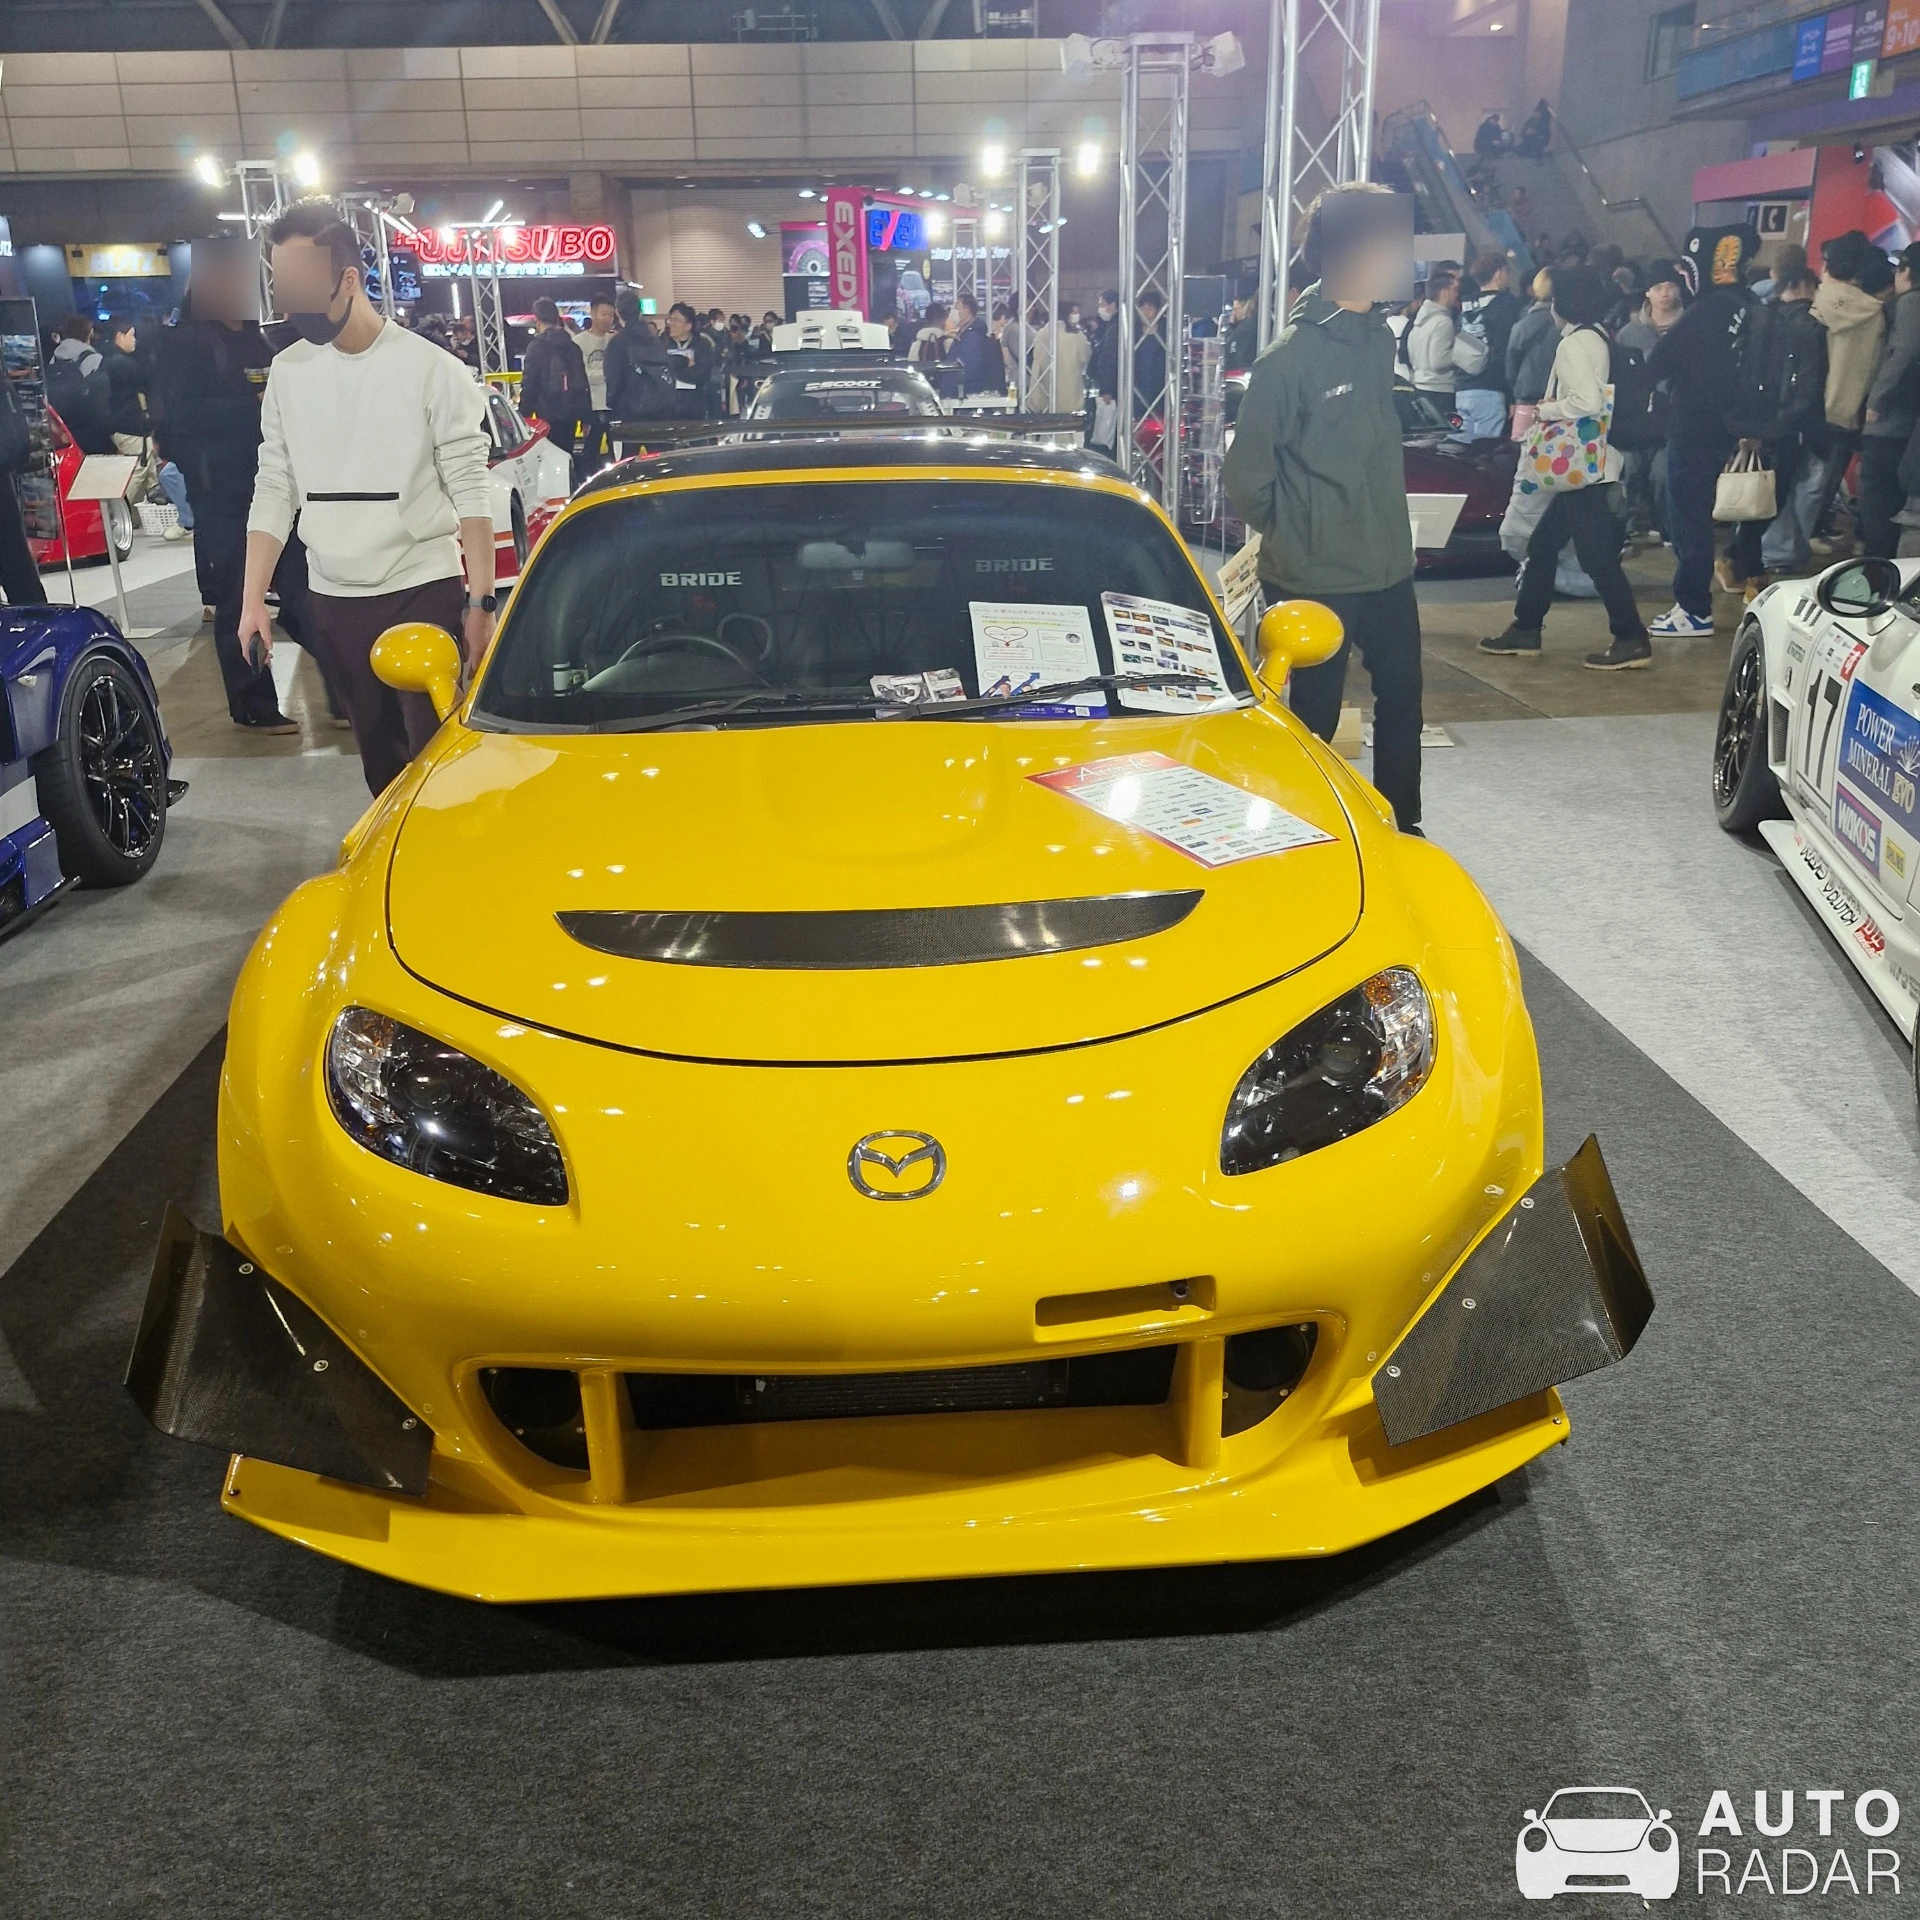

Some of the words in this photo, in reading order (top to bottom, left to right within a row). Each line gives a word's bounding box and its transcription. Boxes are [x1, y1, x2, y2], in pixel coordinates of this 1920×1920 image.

[659, 571, 742, 587] BRIDE
[974, 557, 1054, 573] BRIDE
[1804, 668, 1843, 791] 17
[1855, 702, 1896, 757] POWER
[1847, 737, 1891, 796] MINERAL
[1891, 771, 1916, 814] EVO
[1826, 889, 1859, 926] CLUTCH
